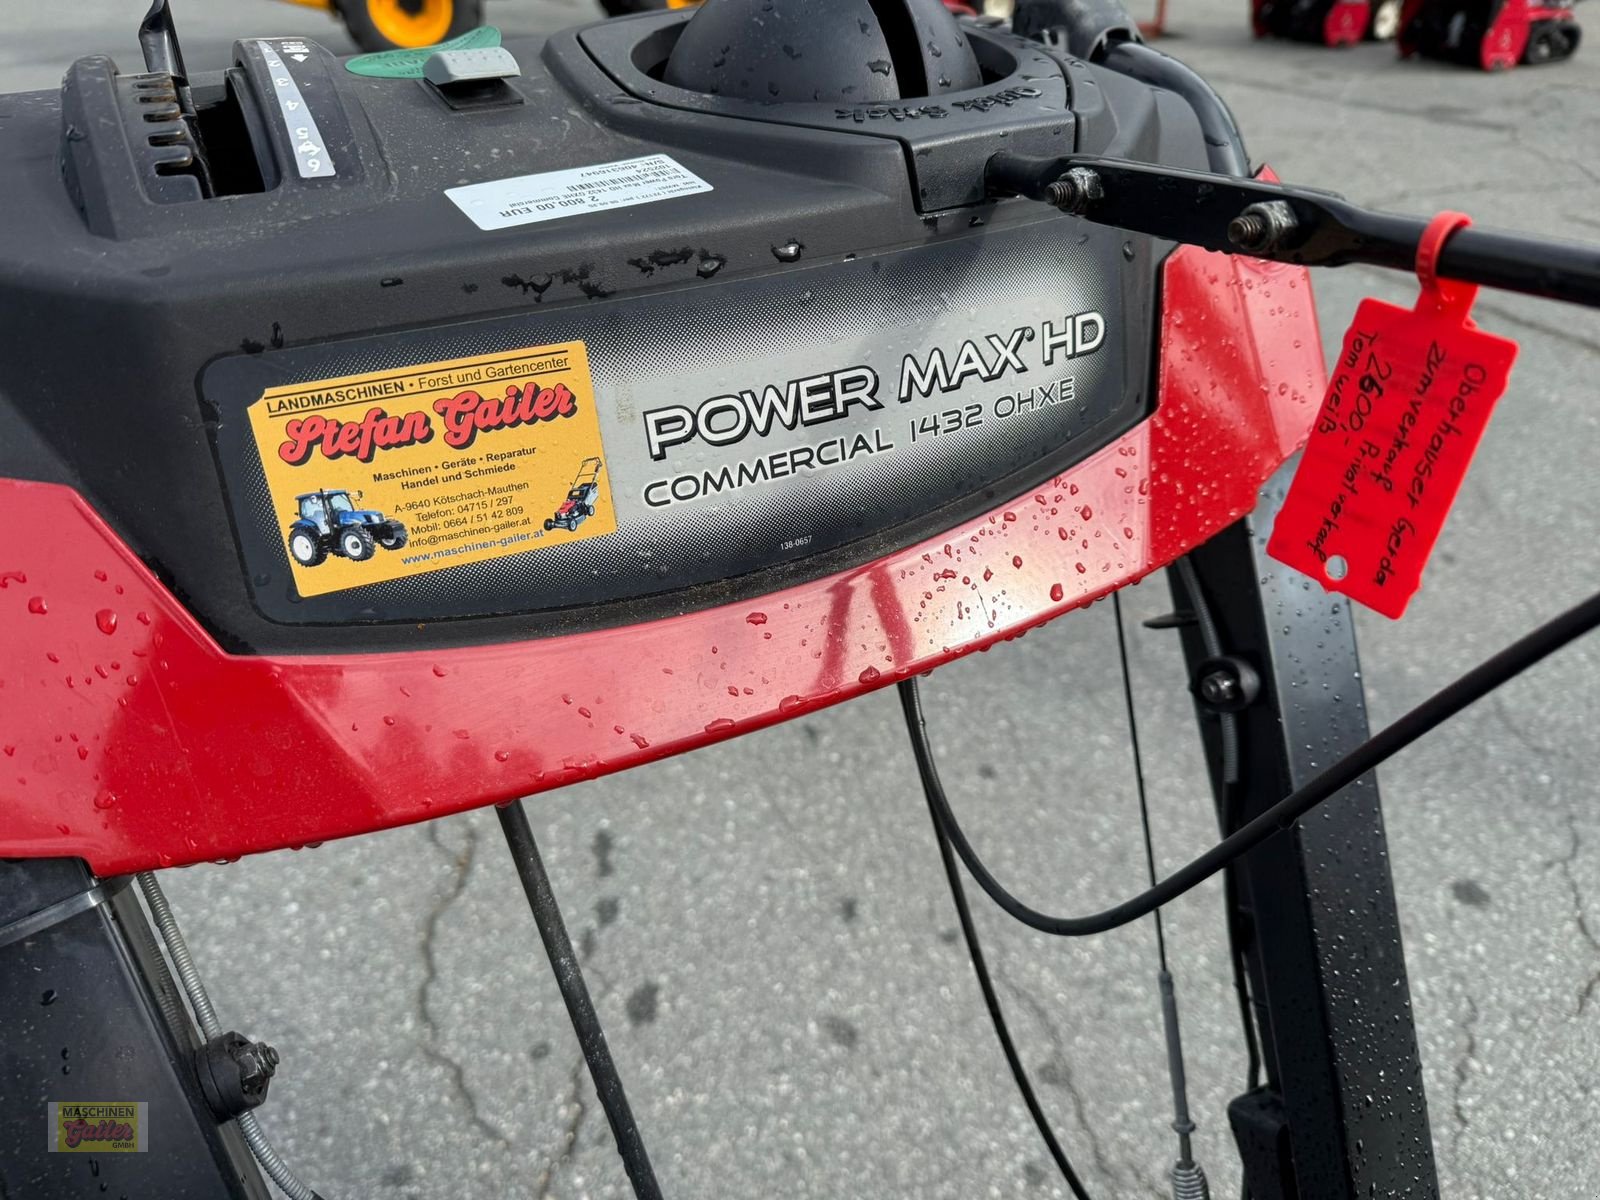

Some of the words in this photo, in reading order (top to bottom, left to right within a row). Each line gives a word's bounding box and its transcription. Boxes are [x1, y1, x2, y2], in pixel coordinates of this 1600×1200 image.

[275, 77, 289, 87] 3
[285, 101, 299, 110] 4
[296, 127, 308, 139] 5
[307, 159, 320, 172] 6
[642, 177, 667, 185] Power
[499, 207, 533, 217] EUR
[509, 195, 560, 208] Commercial
[267, 381, 405, 414] LANDMASCHINEN
[418, 373, 454, 389] Forst
[457, 369, 482, 384] und
[485, 357, 569, 379] Gartencenter
[643, 365, 885, 461] POWER
[1042, 310, 1105, 366] HD
[278, 407, 435, 466] Stefan
[433, 382, 578, 450] Gailer
[1406, 362, 1487, 509] Oberhauser
[643, 429, 894, 507] COMMERCIAL
[910, 404, 983, 442] 1432
[994, 377, 1074, 419] OHXE
[373, 464, 432, 482] Maschinen
[441, 457, 477, 471] Geräte
[486, 446, 537, 463] Reparatur
[401, 476, 439, 490] Handel
[442, 471, 462, 483] und
[464, 462, 516, 479] Schmiede
[394, 499, 431, 514] A-9640
[433, 481, 530, 506] Kötschach-Mauthen
[416, 508, 455, 522] Telefon:
[457, 501, 488, 514] 04715
[496, 495, 514, 507] 297
[409, 518, 531, 549] info@maschinen-gailer.at
[411, 521, 442, 536] Mobil:
[443, 517, 468, 529] 0664
[476, 513, 488, 522] 51
[491, 510, 503, 520] 42
[505, 505, 524, 517] 809
[401, 528, 545, 565] www.maschinen-gailer.at
[780, 535, 812, 550] 138-0657
[1375, 517, 1416, 587] Gerda
